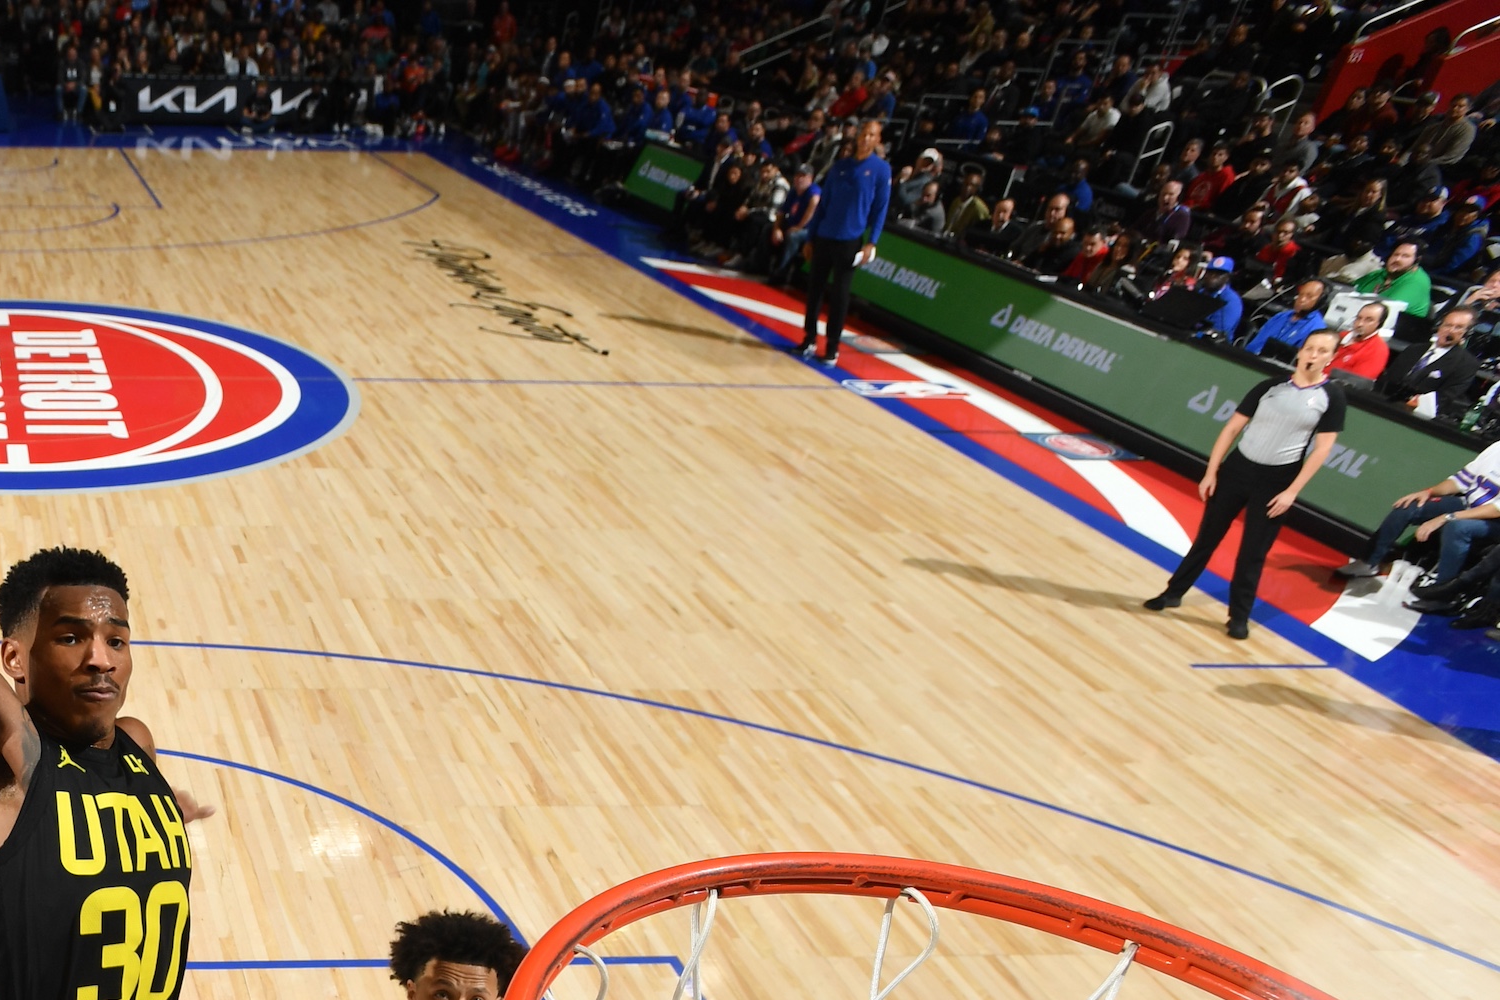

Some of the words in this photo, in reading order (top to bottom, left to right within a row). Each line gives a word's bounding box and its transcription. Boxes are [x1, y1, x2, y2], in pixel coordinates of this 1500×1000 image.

[891, 266, 940, 299] DENTAL
[1008, 314, 1057, 348] DELTA
[1051, 332, 1118, 373] DENTAL
[12, 328, 130, 439] DETROIT
[55, 790, 192, 876] UTAH
